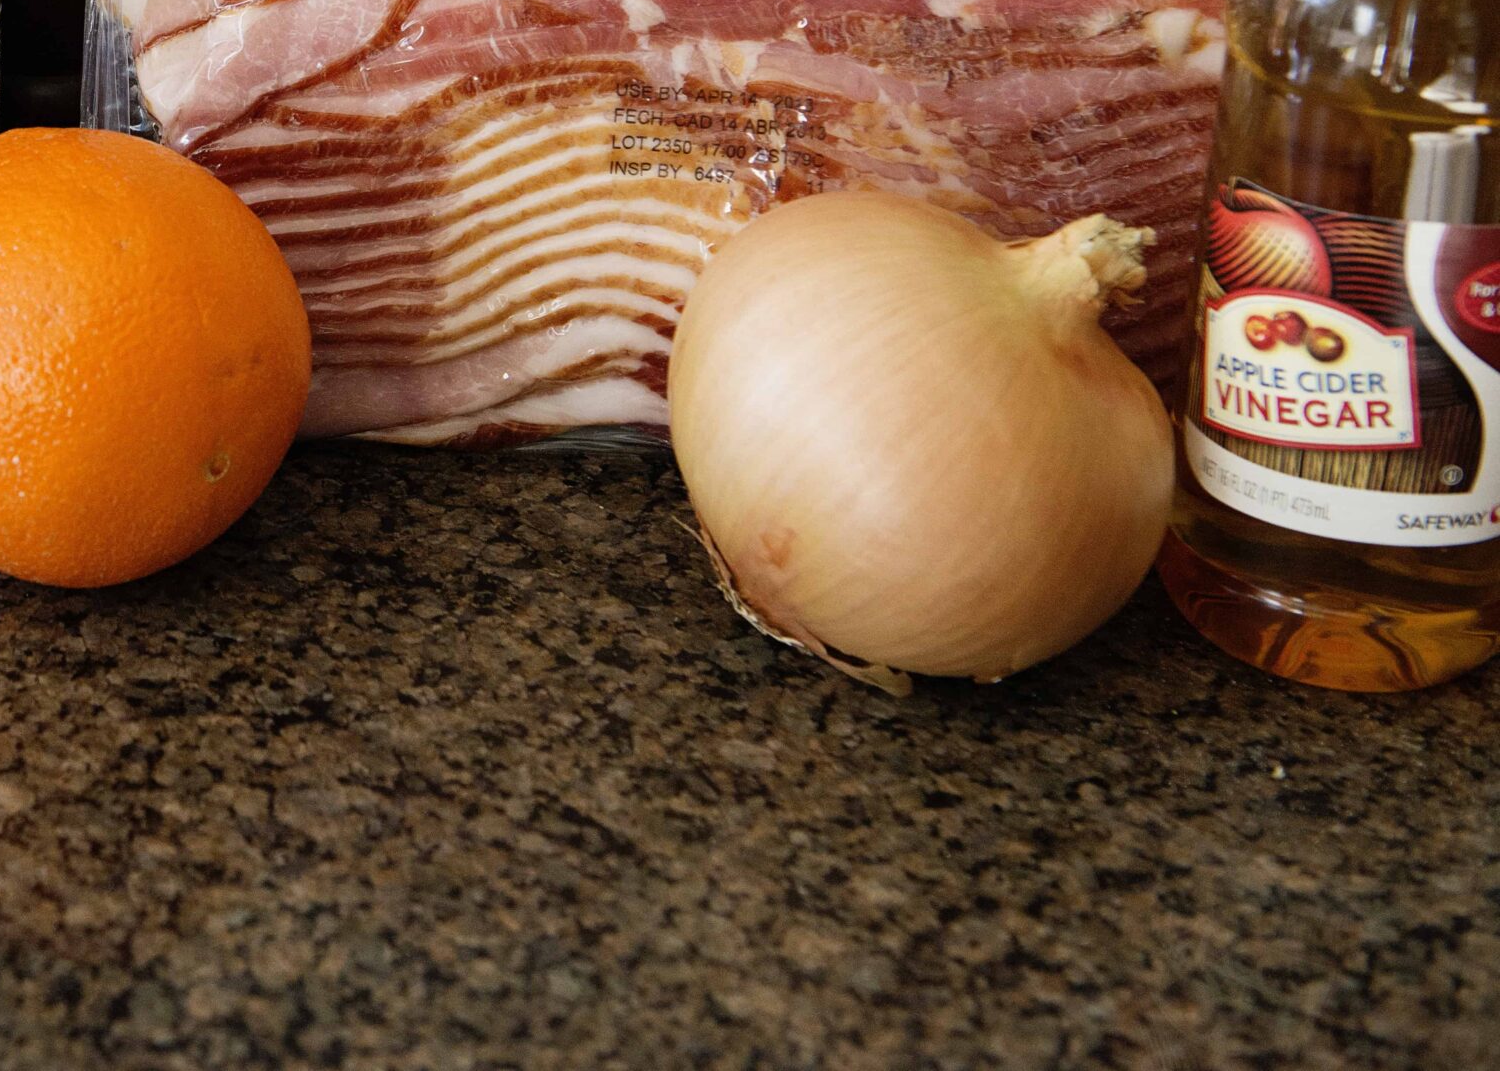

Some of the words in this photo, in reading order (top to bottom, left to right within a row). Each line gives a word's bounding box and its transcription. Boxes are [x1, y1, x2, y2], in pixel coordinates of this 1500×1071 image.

[616, 83, 653, 99] USE
[659, 86, 683, 101] BY
[695, 89, 733, 105] APR
[740, 91, 757, 106] 14
[674, 112, 712, 129] CAD
[720, 117, 738, 131] 14
[744, 119, 781, 135] ABR
[611, 134, 648, 151] LOT
[652, 137, 692, 155] 2350
[610, 161, 652, 177] INSP
[658, 163, 683, 180] BY
[694, 166, 736, 185] 6497
[1216, 352, 1286, 390] APPLE
[1296, 370, 1387, 395] CIDER
[1214, 378, 1395, 429] VINEGAR
[1397, 511, 1488, 531] SAFEWAY
